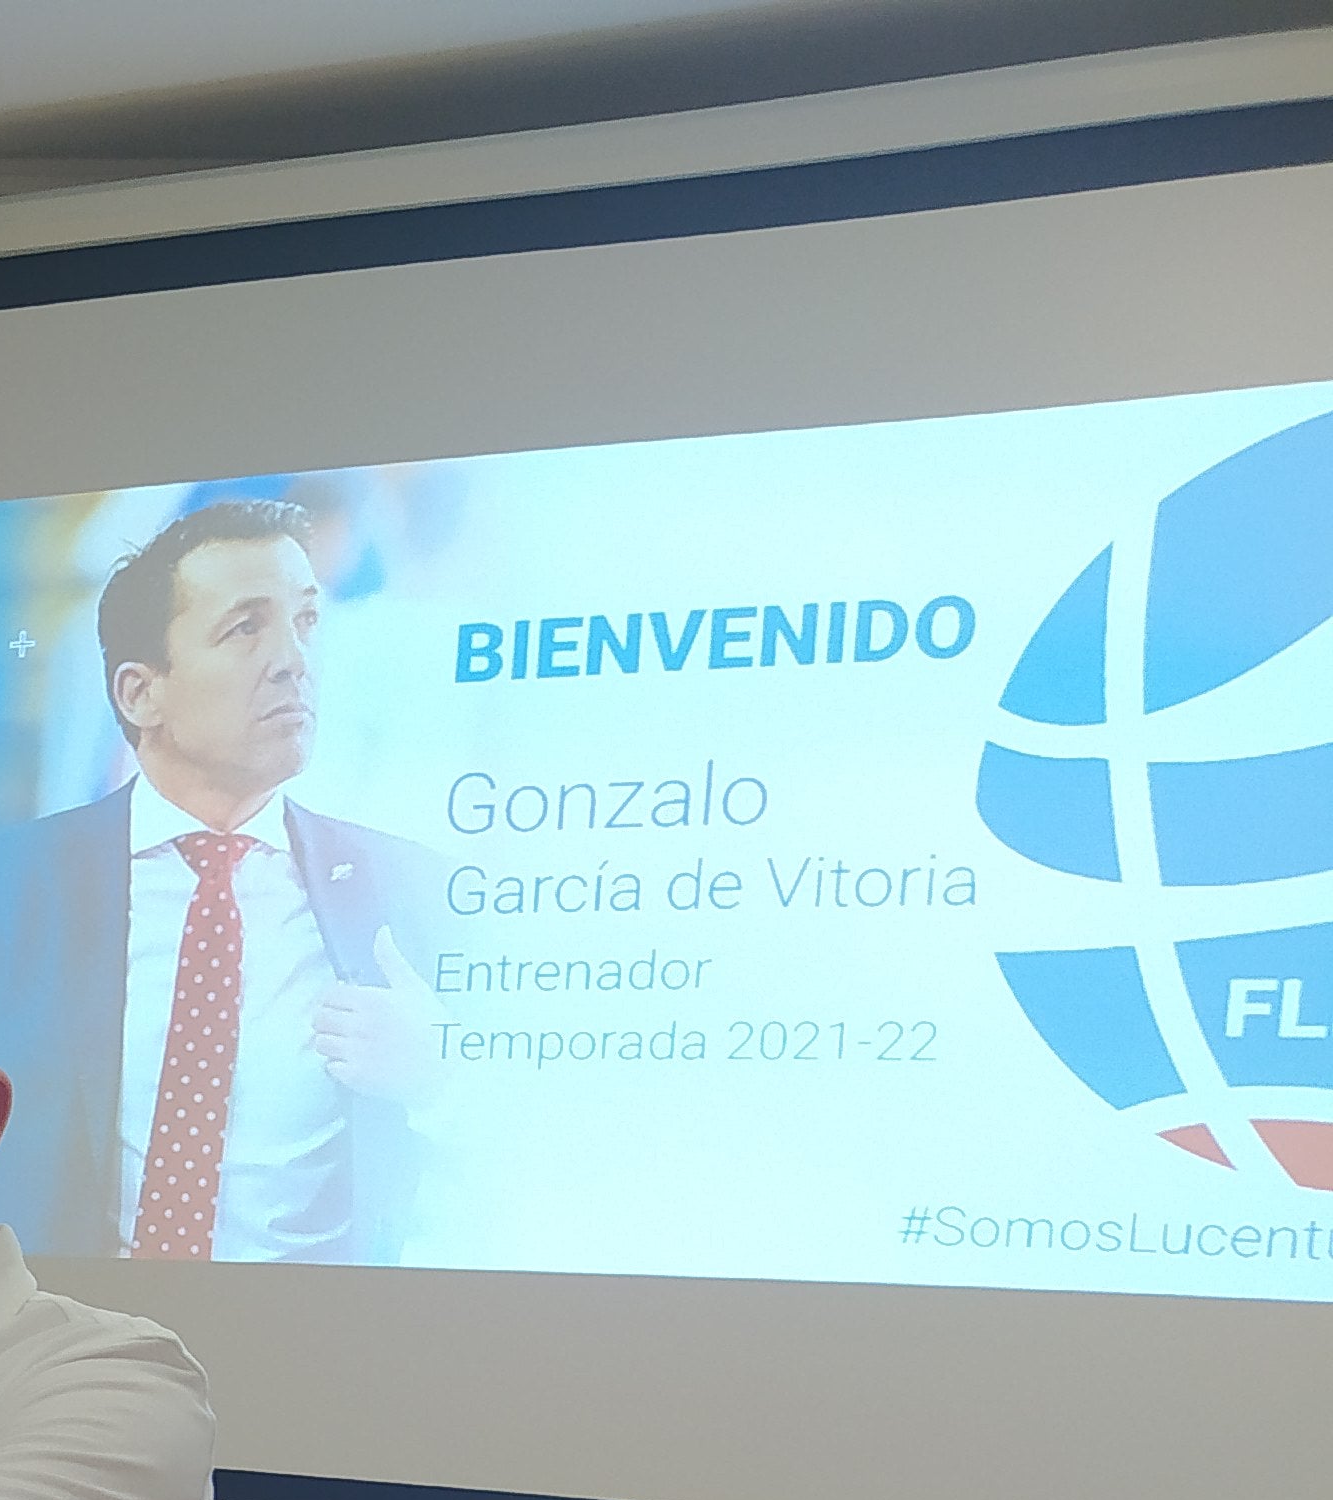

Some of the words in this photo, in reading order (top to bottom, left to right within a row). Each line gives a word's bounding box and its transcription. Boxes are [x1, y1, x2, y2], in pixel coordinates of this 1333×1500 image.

[454, 593, 977, 684] BIENVENIDO
[446, 759, 769, 835] Gonzalo
[446, 860, 642, 917] García
[666, 857, 744, 911] de
[765, 852, 978, 908] Vitoria
[435, 949, 713, 994] Entrenador
[430, 1020, 707, 1071] Temporada
[726, 1020, 939, 1062] 2021-22
